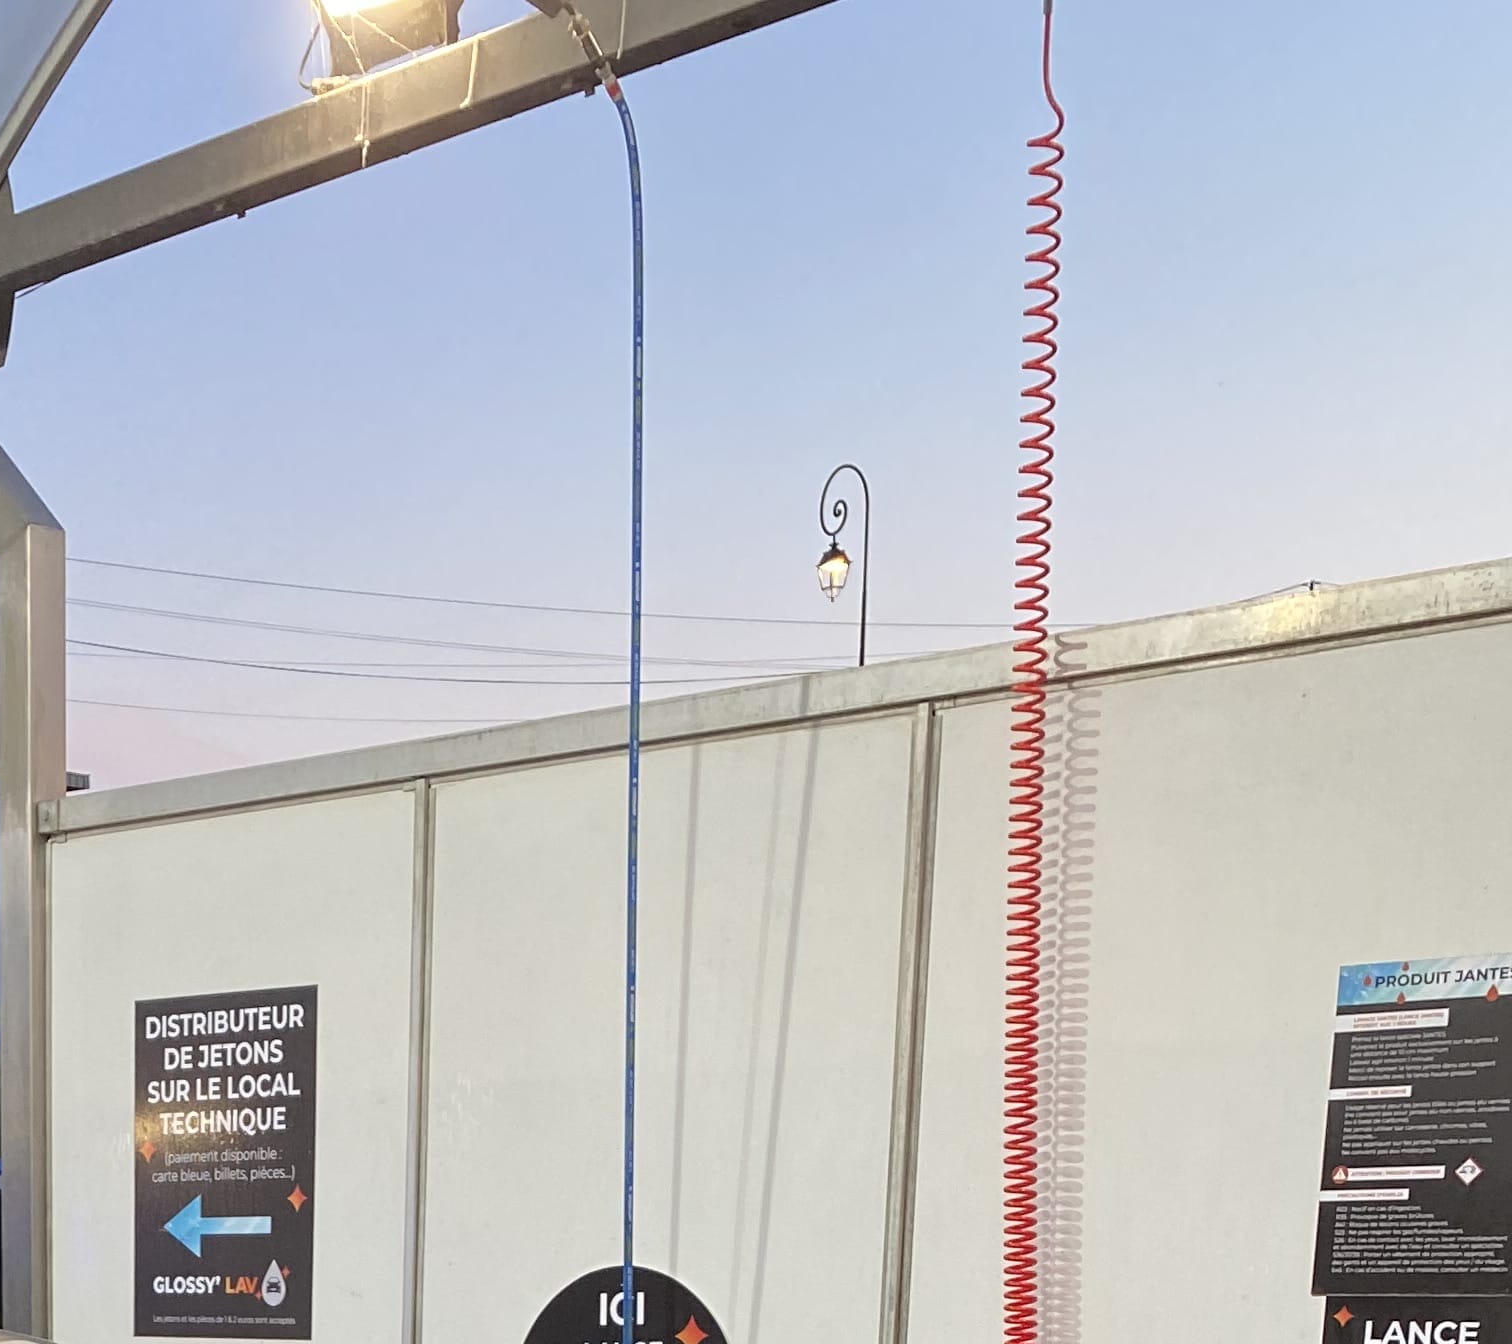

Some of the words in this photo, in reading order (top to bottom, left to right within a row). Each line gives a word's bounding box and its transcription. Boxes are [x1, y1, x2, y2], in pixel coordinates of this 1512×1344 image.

[1374, 970, 1451, 989] PRODUIT
[1454, 966, 1512, 983] JANTE
[145, 1003, 305, 1040] DISTRIBUTEUR
[164, 1046, 194, 1071] DE
[197, 1039, 284, 1069] JETONS
[147, 1079, 190, 1104] SUR
[196, 1077, 222, 1101] LE
[227, 1072, 301, 1100] LOCAL
[159, 1106, 287, 1136] TECHNIQUE
[151, 1171, 178, 1183] carte
[225, 1276, 259, 1294] LAV
[599, 1291, 646, 1326] ICI
